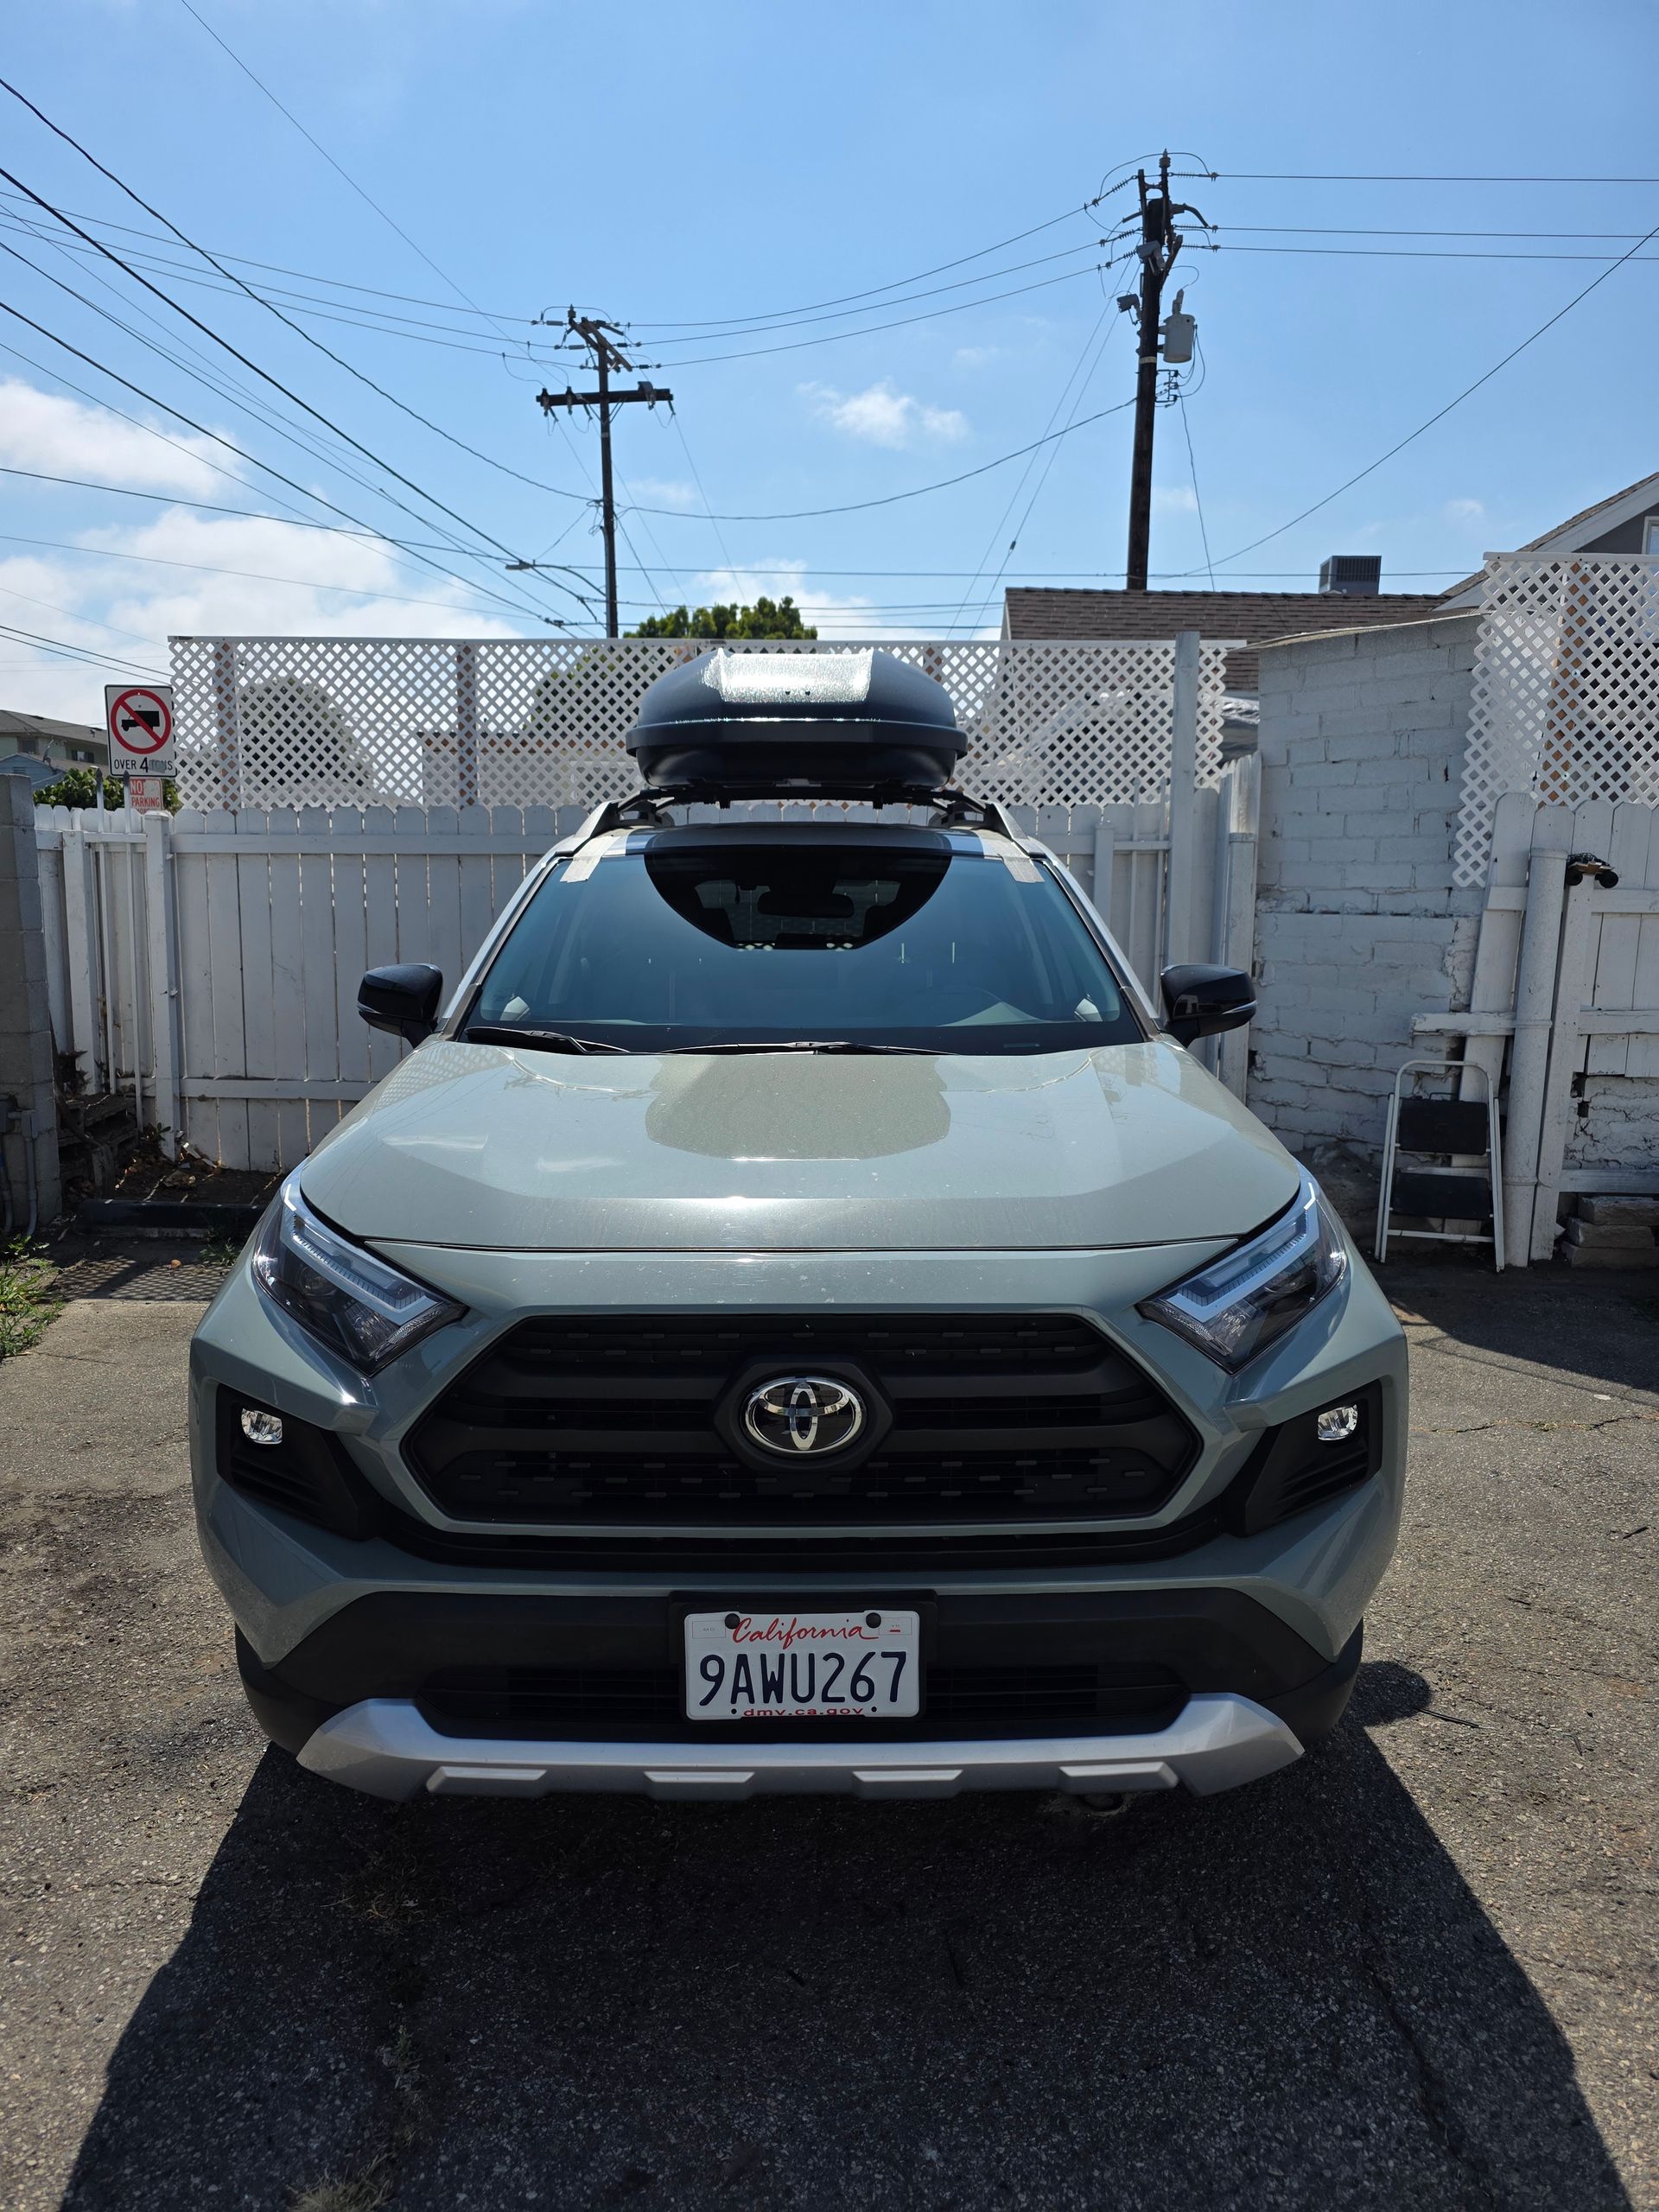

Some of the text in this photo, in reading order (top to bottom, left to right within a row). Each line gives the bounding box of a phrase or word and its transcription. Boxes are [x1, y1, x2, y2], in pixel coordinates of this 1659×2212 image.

[114, 760, 137, 770] OVER
[140, 757, 149, 773] 4
[130, 780, 143, 794] NO
[131, 798, 160, 808] PARKING
[733, 1617, 879, 1649] California
[699, 1651, 907, 1707] 9AWU267
[743, 1707, 864, 1717] dmv.ca.gov
